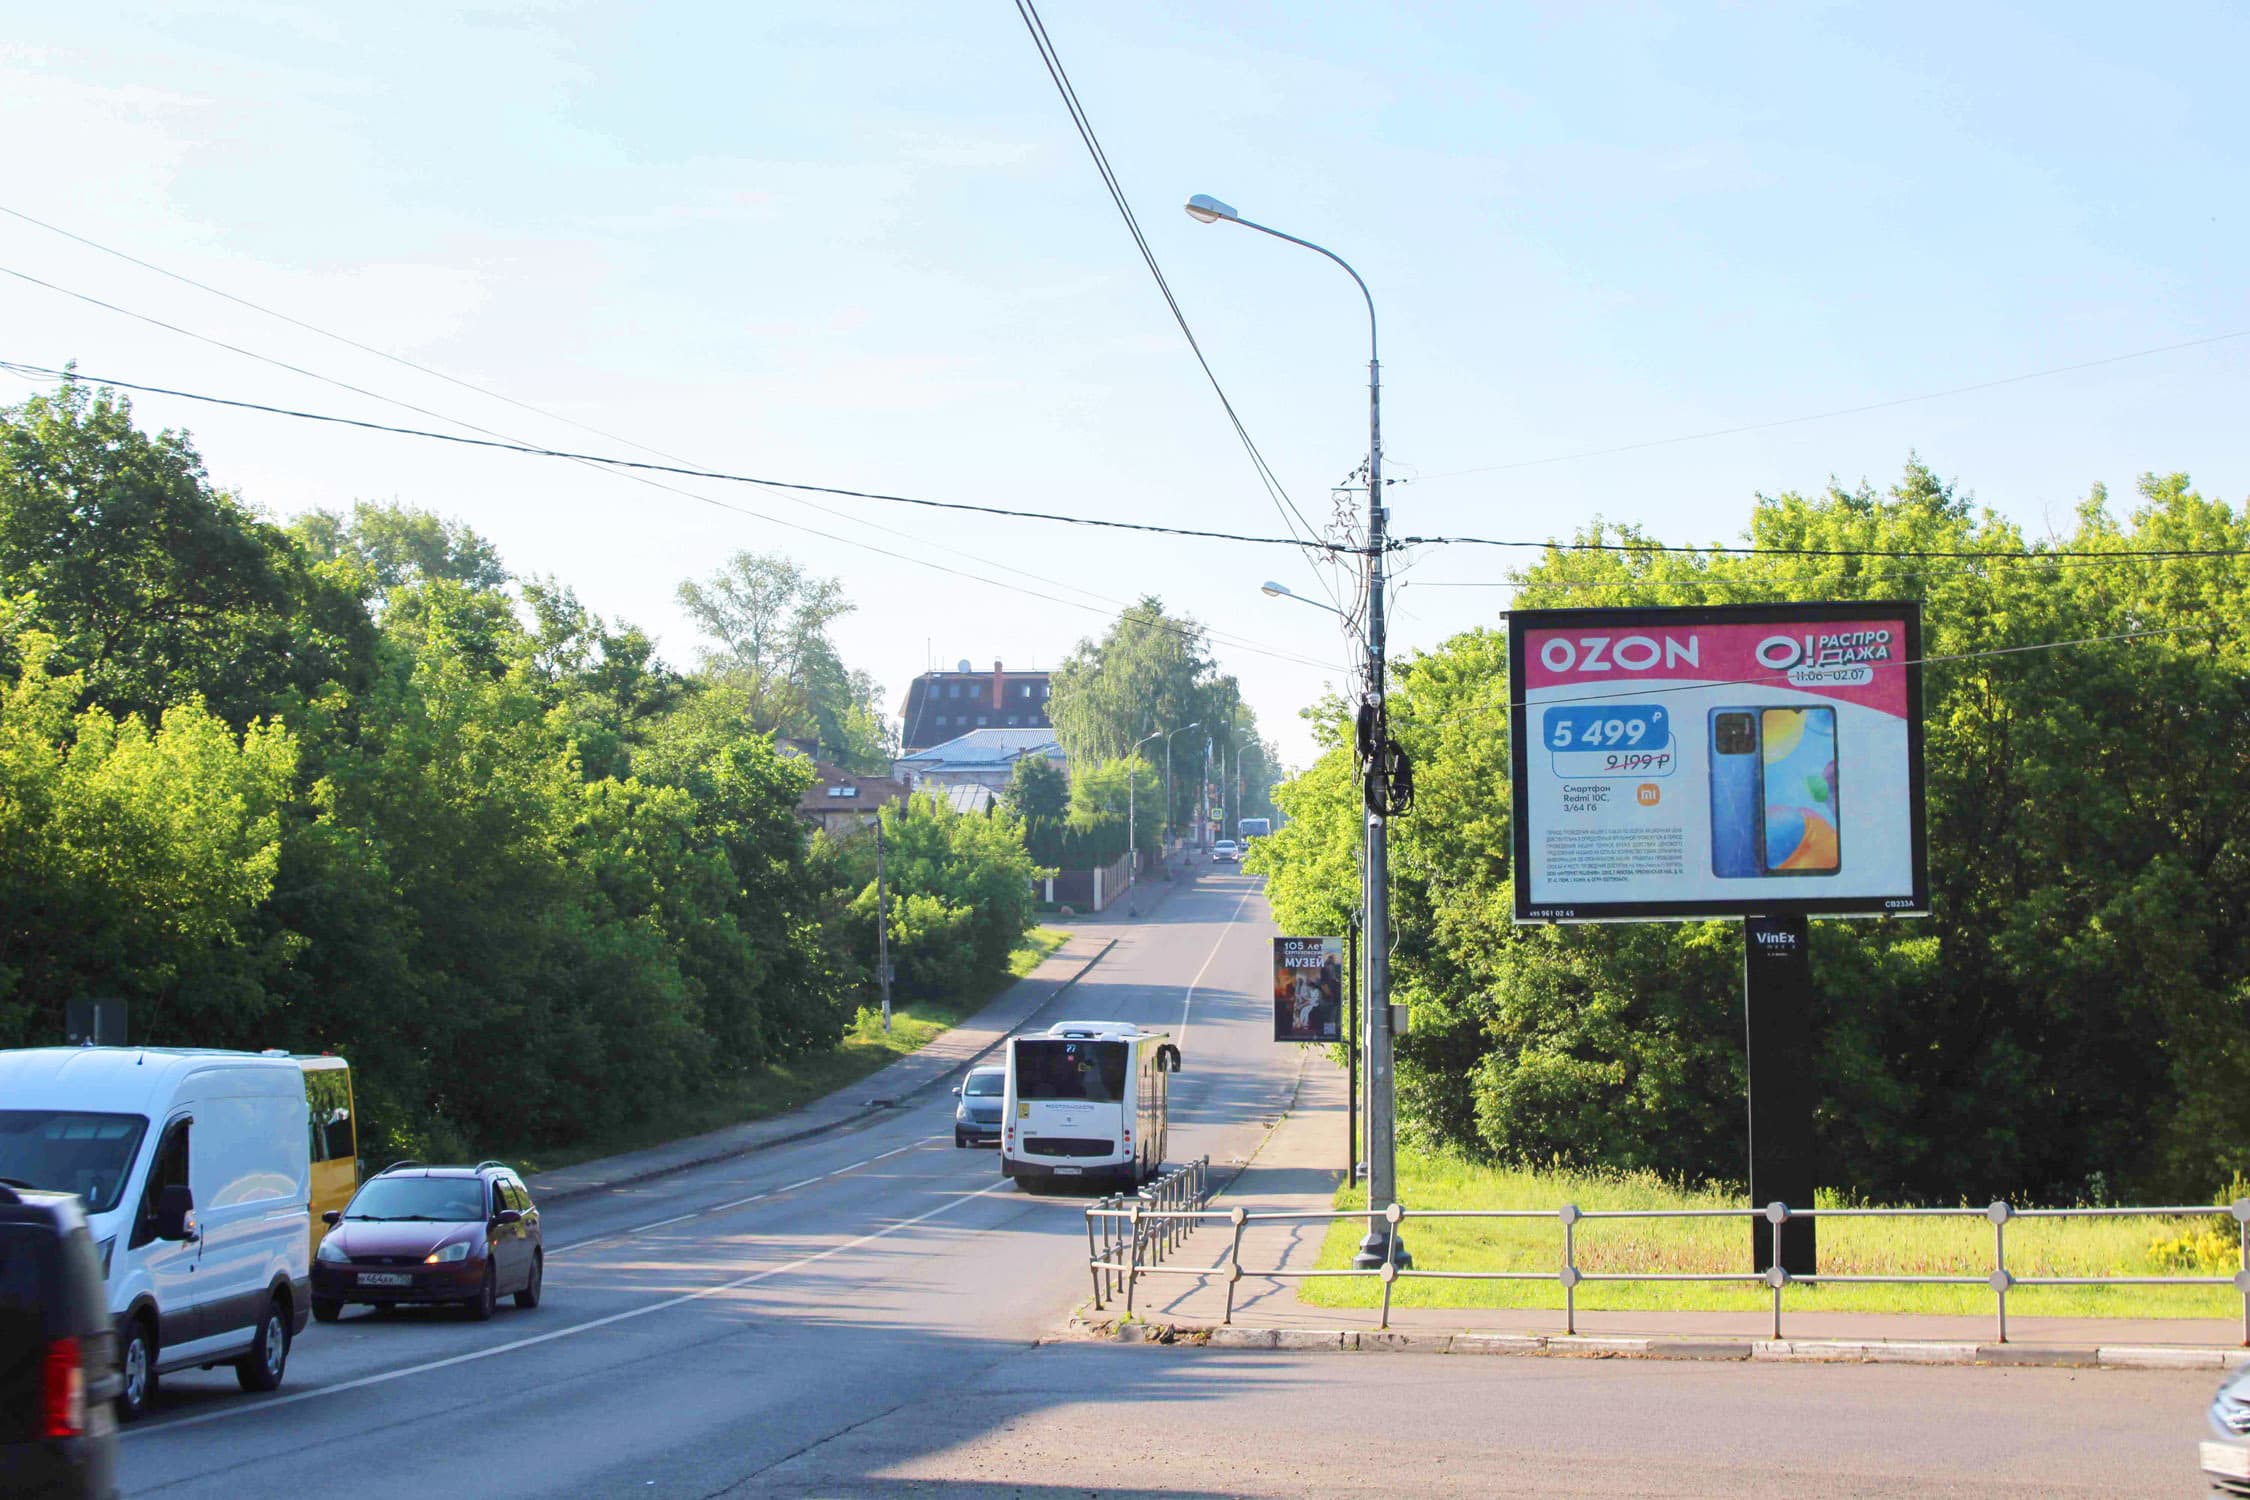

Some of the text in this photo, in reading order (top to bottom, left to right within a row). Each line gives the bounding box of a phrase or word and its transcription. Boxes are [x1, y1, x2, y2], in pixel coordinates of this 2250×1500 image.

[1819, 629, 1891, 649] РАСПРО
[1540, 635, 1700, 673] OZON
[1755, 634, 1815, 670] О!
[1818, 644, 1889, 666] ДАЖА
[1552, 720, 1573, 747] 5
[1581, 718, 1647, 746] 499
[1623, 754, 1652, 770] 199
[1563, 784, 1611, 794] Смартфон
[1563, 794, 1590, 802] Redmi
[1563, 803, 1597, 812] 3/64 Гб
[1756, 932, 1796, 944] VinEx
[1284, 941, 1304, 950] 105
[1285, 955, 1325, 968] МУЗЕЙ
